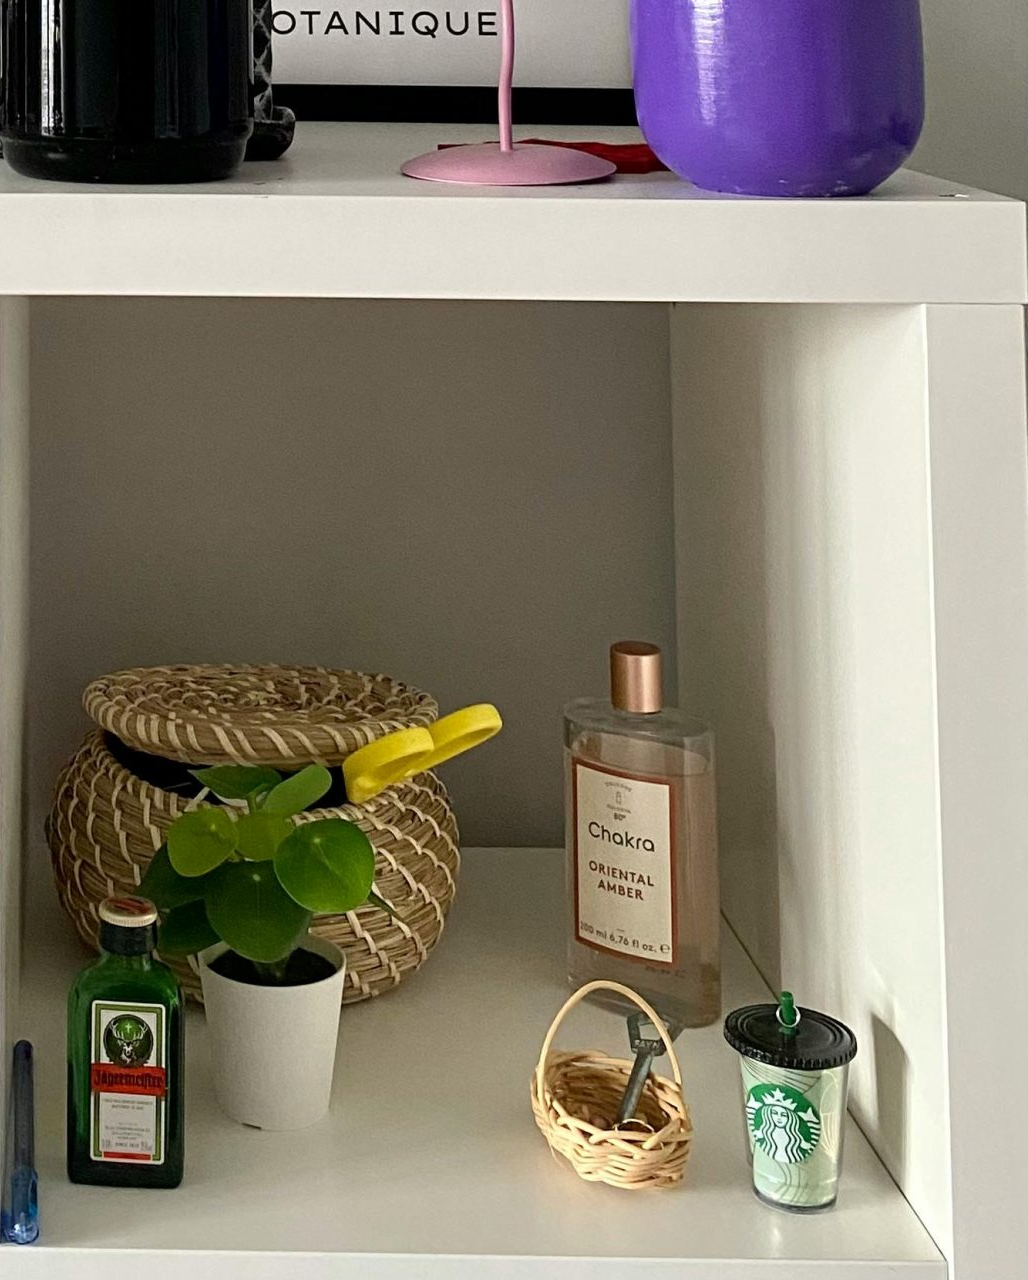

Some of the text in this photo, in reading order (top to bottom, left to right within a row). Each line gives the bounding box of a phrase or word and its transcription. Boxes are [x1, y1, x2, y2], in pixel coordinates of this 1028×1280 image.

[271, 10, 498, 39] OTANIQUE
[588, 821, 655, 853] Chakra
[588, 860, 655, 887] ORIENTAL
[597, 879, 644, 901] AMBER
